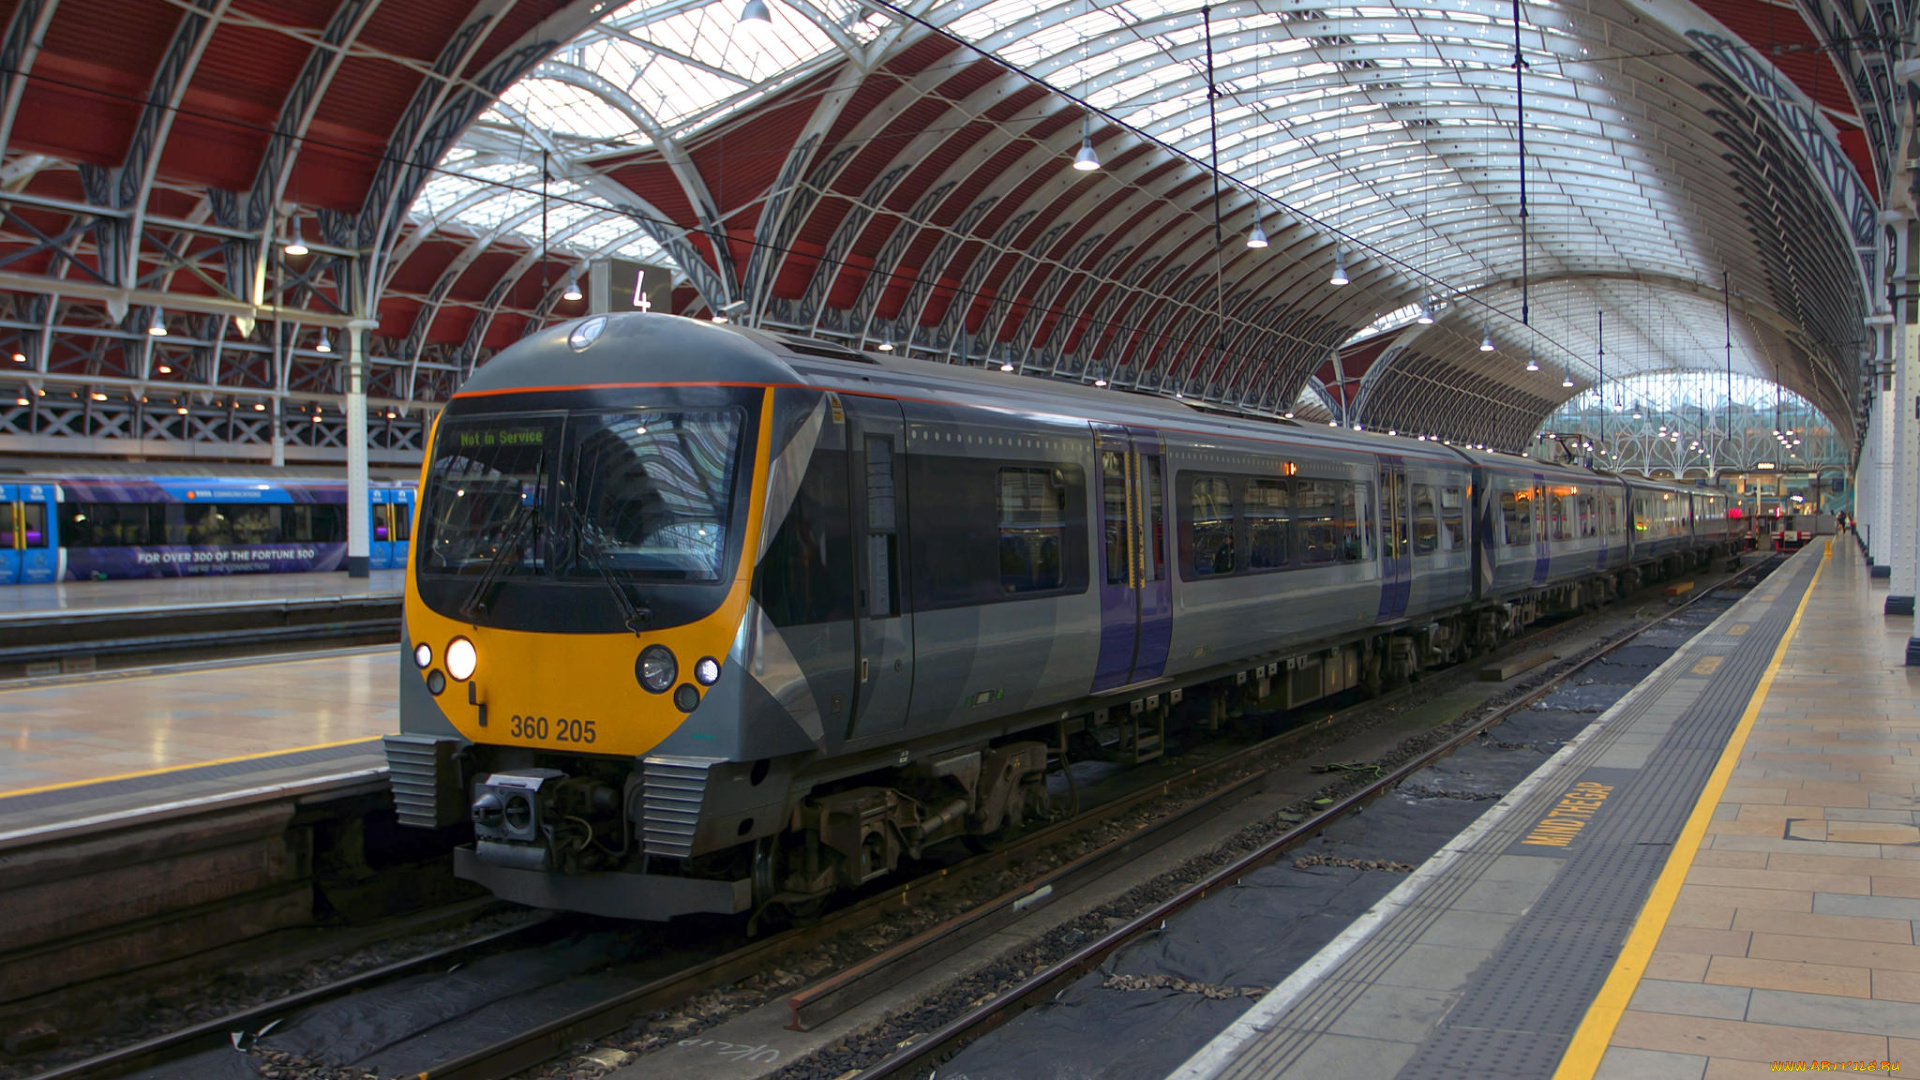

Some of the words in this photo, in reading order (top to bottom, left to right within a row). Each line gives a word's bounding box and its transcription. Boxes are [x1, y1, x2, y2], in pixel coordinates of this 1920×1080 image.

[633, 269, 652, 313] 4
[460, 432, 481, 447] Not
[485, 431, 495, 445] in
[499, 429, 543, 444] Service
[137, 552, 160, 564] FOR
[162, 551, 191, 563] OVER
[216, 551, 229, 562] OF
[232, 550, 250, 561] THE
[252, 549, 295, 561] FORTUNE
[510, 714, 548, 740] 360
[556, 718, 596, 744] 205
[1565, 781, 1614, 800] GAP
[1547, 799, 1602, 818] THE
[1520, 818, 1585, 847] MIND
